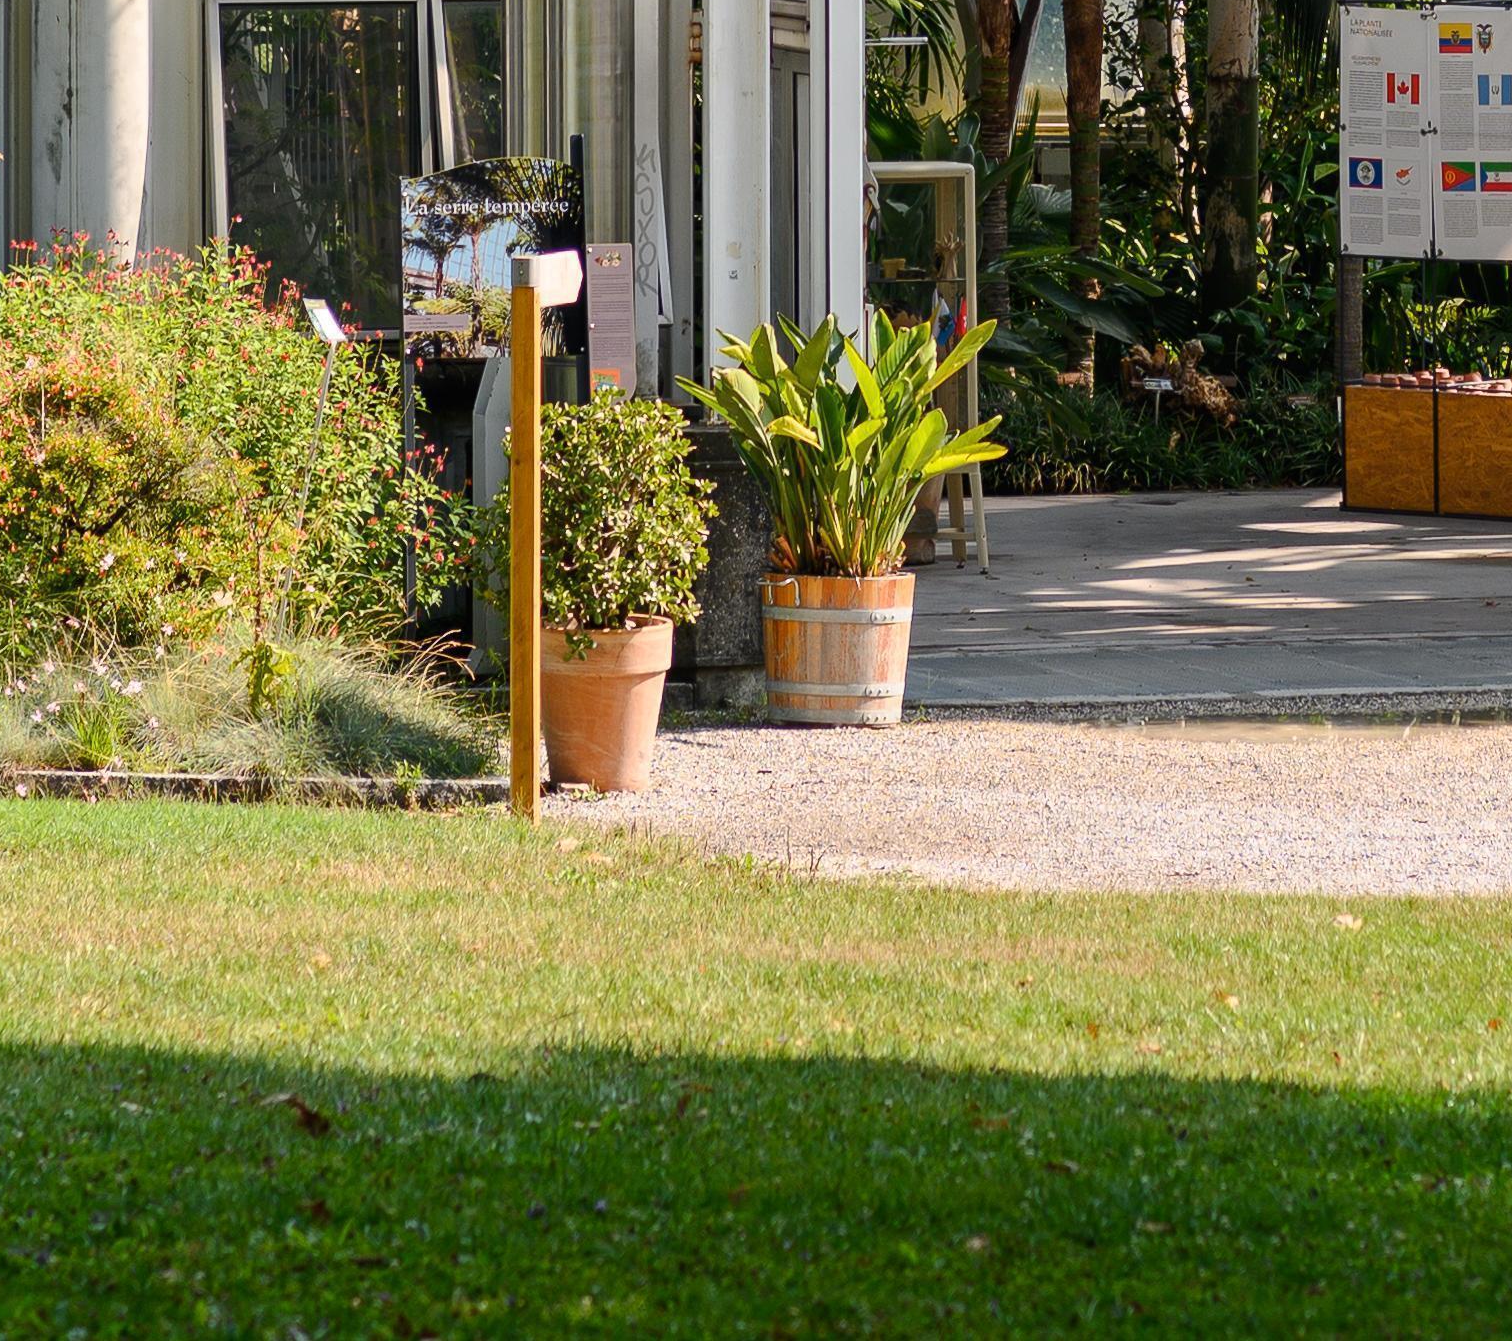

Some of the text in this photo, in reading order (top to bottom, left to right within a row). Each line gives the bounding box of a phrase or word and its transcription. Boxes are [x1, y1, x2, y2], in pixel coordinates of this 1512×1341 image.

[405, 194, 570, 217] La serre tempérée
